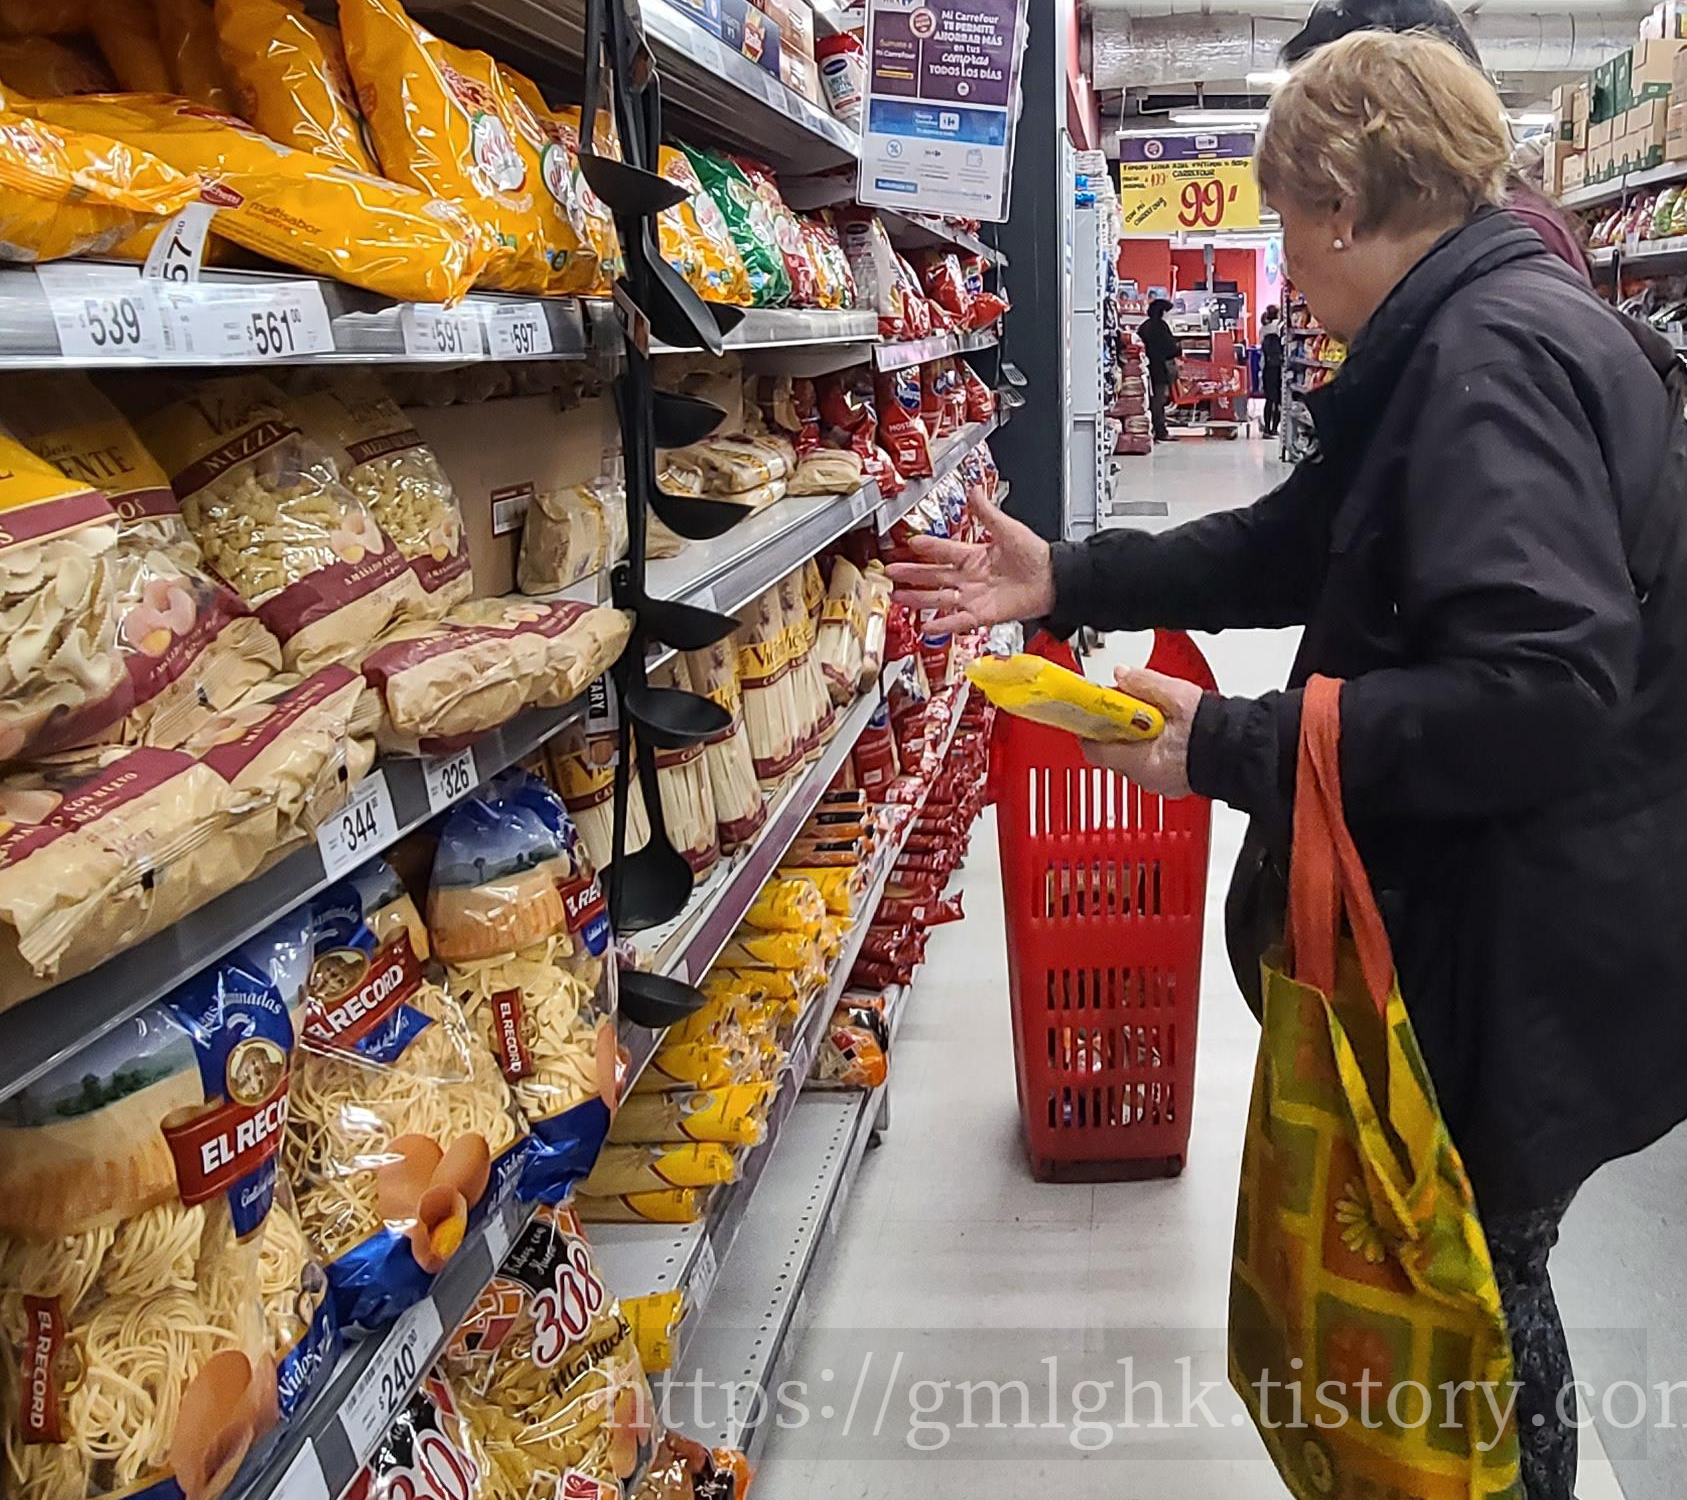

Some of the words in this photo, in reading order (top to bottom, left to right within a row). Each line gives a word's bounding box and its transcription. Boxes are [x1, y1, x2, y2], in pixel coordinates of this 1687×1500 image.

[955, 12, 999, 24] Carrefour
[934, 30, 981, 43] AHORRAR
[953, 45, 964, 53] en
[966, 45, 981, 54] tus
[930, 64, 960, 76] TODOS
[961, 64, 978, 78] LOS
[326, 964, 405, 1034] RECORD
[500, 1002, 512, 1019] EL
[502, 1019, 522, 1073] RECORD
[200, 1133, 235, 1176] EL
[530, 1242, 604, 1367] 308
[37, 1310, 52, 1333] EL
[30, 1336, 52, 1429] RECORD
